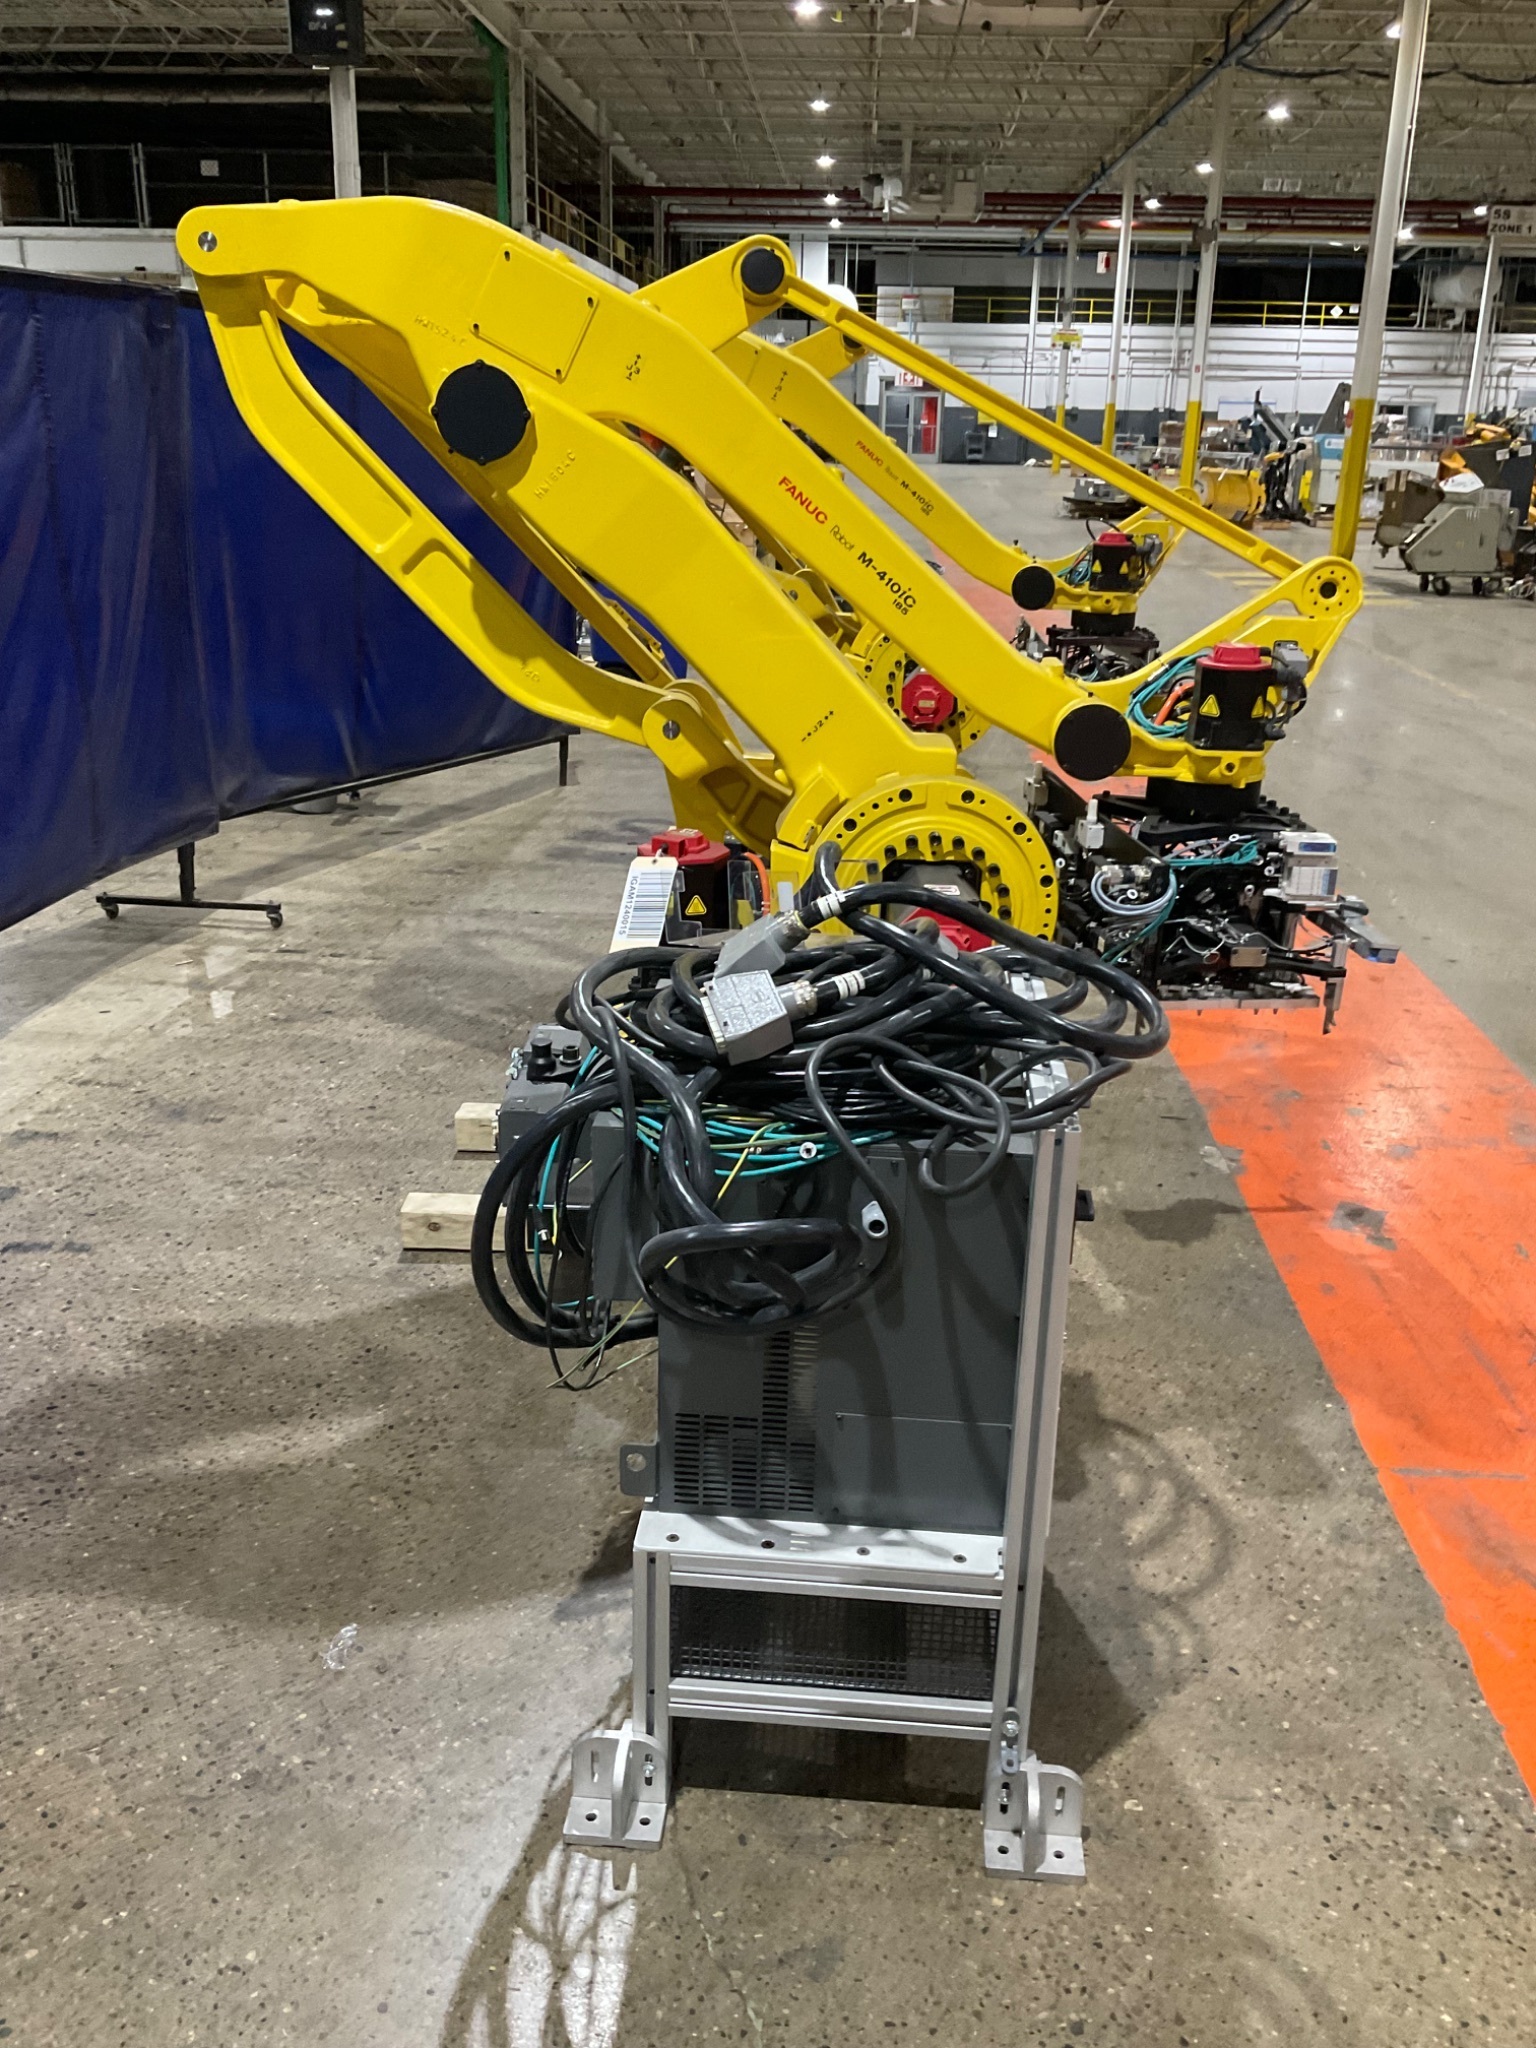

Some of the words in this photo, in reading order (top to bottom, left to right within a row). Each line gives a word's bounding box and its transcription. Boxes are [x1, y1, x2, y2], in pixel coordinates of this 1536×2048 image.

[1490, 223, 1522, 234] ZONE
[855, 440, 883, 466] FANUC
[778, 476, 828, 525] FANUC
[829, 524, 855, 551] Robot
[857, 551, 917, 608] M-410iC
[892, 599, 908, 616] 185
[618, 875, 639, 936] IGAM1240015
